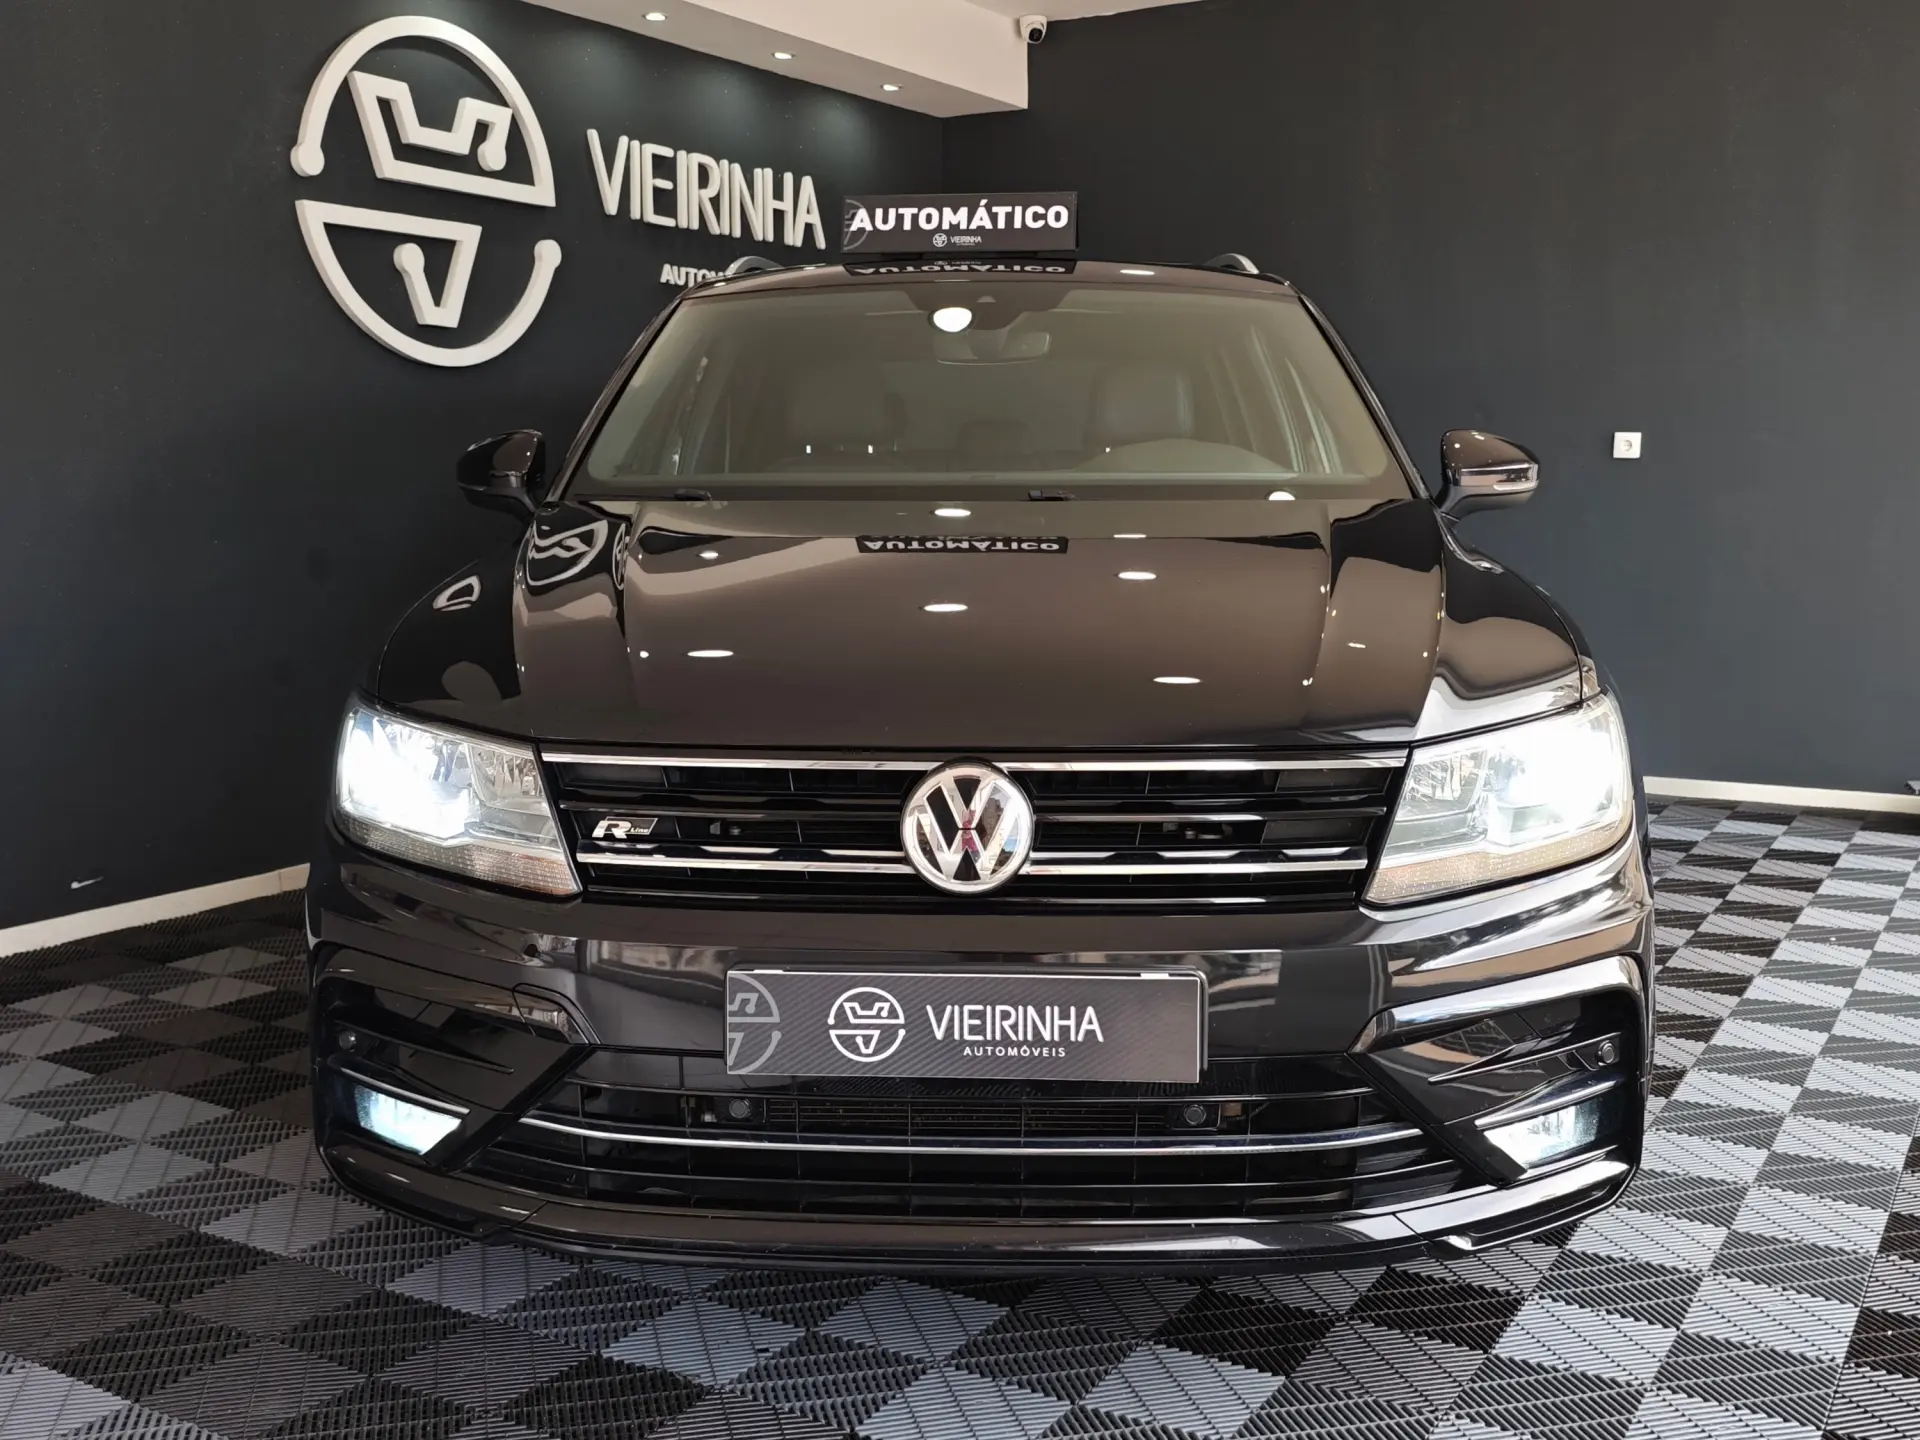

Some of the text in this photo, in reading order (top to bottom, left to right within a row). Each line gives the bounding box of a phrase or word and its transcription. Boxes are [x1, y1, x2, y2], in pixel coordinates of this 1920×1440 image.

[587, 129, 826, 250] VIEIRINHA
[850, 199, 1068, 231] AUTOMÁTICO
[592, 820, 631, 839] R
[926, 1004, 1104, 1043] VIEIRINHA
[963, 1045, 1066, 1057] AUTOMÓVEIS
